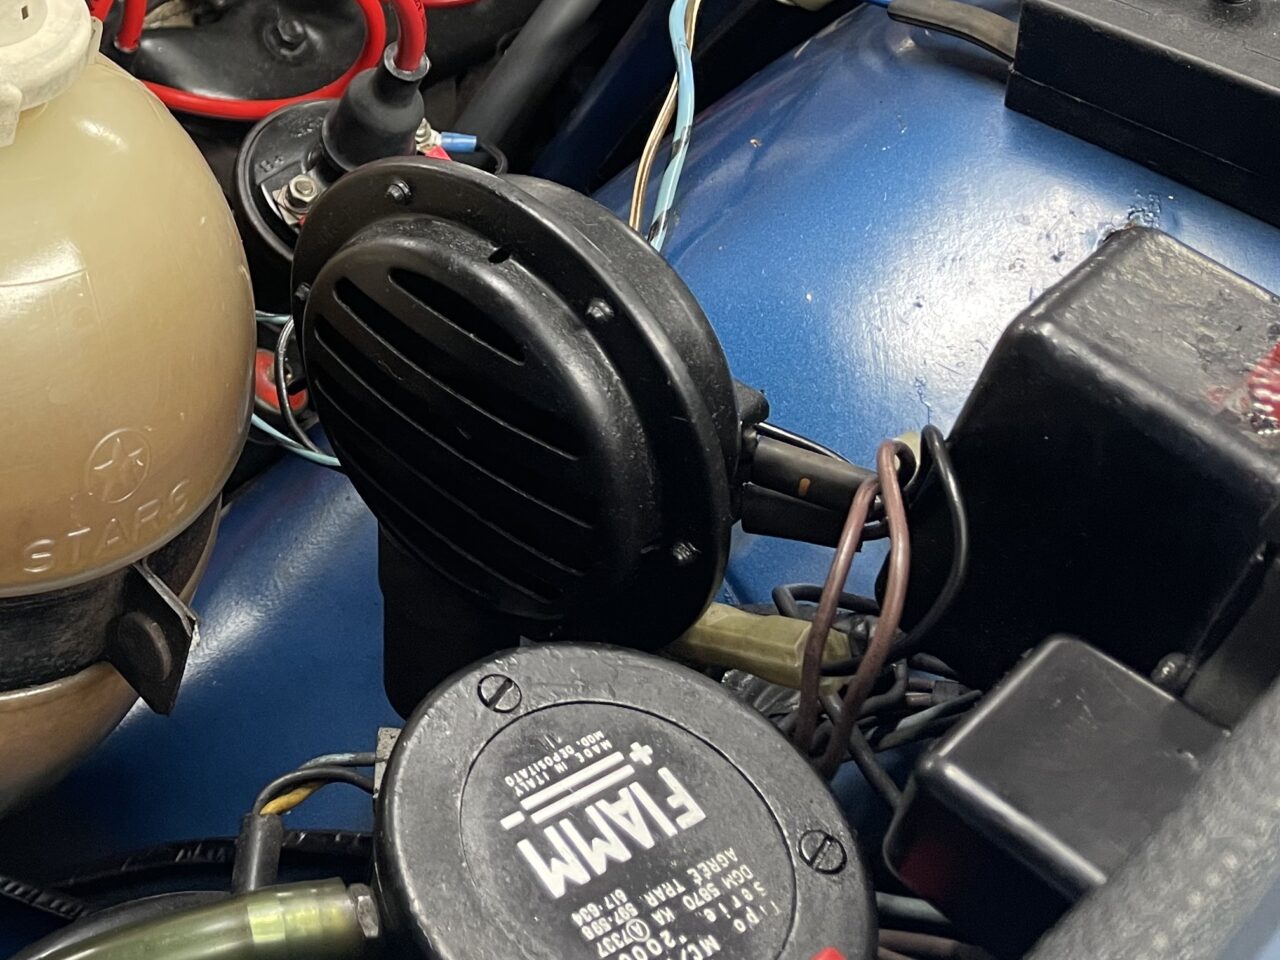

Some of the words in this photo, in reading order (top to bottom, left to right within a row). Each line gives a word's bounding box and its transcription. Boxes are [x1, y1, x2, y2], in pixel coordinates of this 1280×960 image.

[574, 739, 613, 764] MADE
[575, 730, 605, 747] MOD.
[504, 744, 575, 788] DEPOSITATO
[554, 761, 568, 774] IN
[514, 771, 550, 798] ITALY
[516, 766, 708, 900] FIAMM
[721, 864, 754, 890] DGM
[682, 882, 721, 911] 5870
[650, 906, 675, 926] KA
